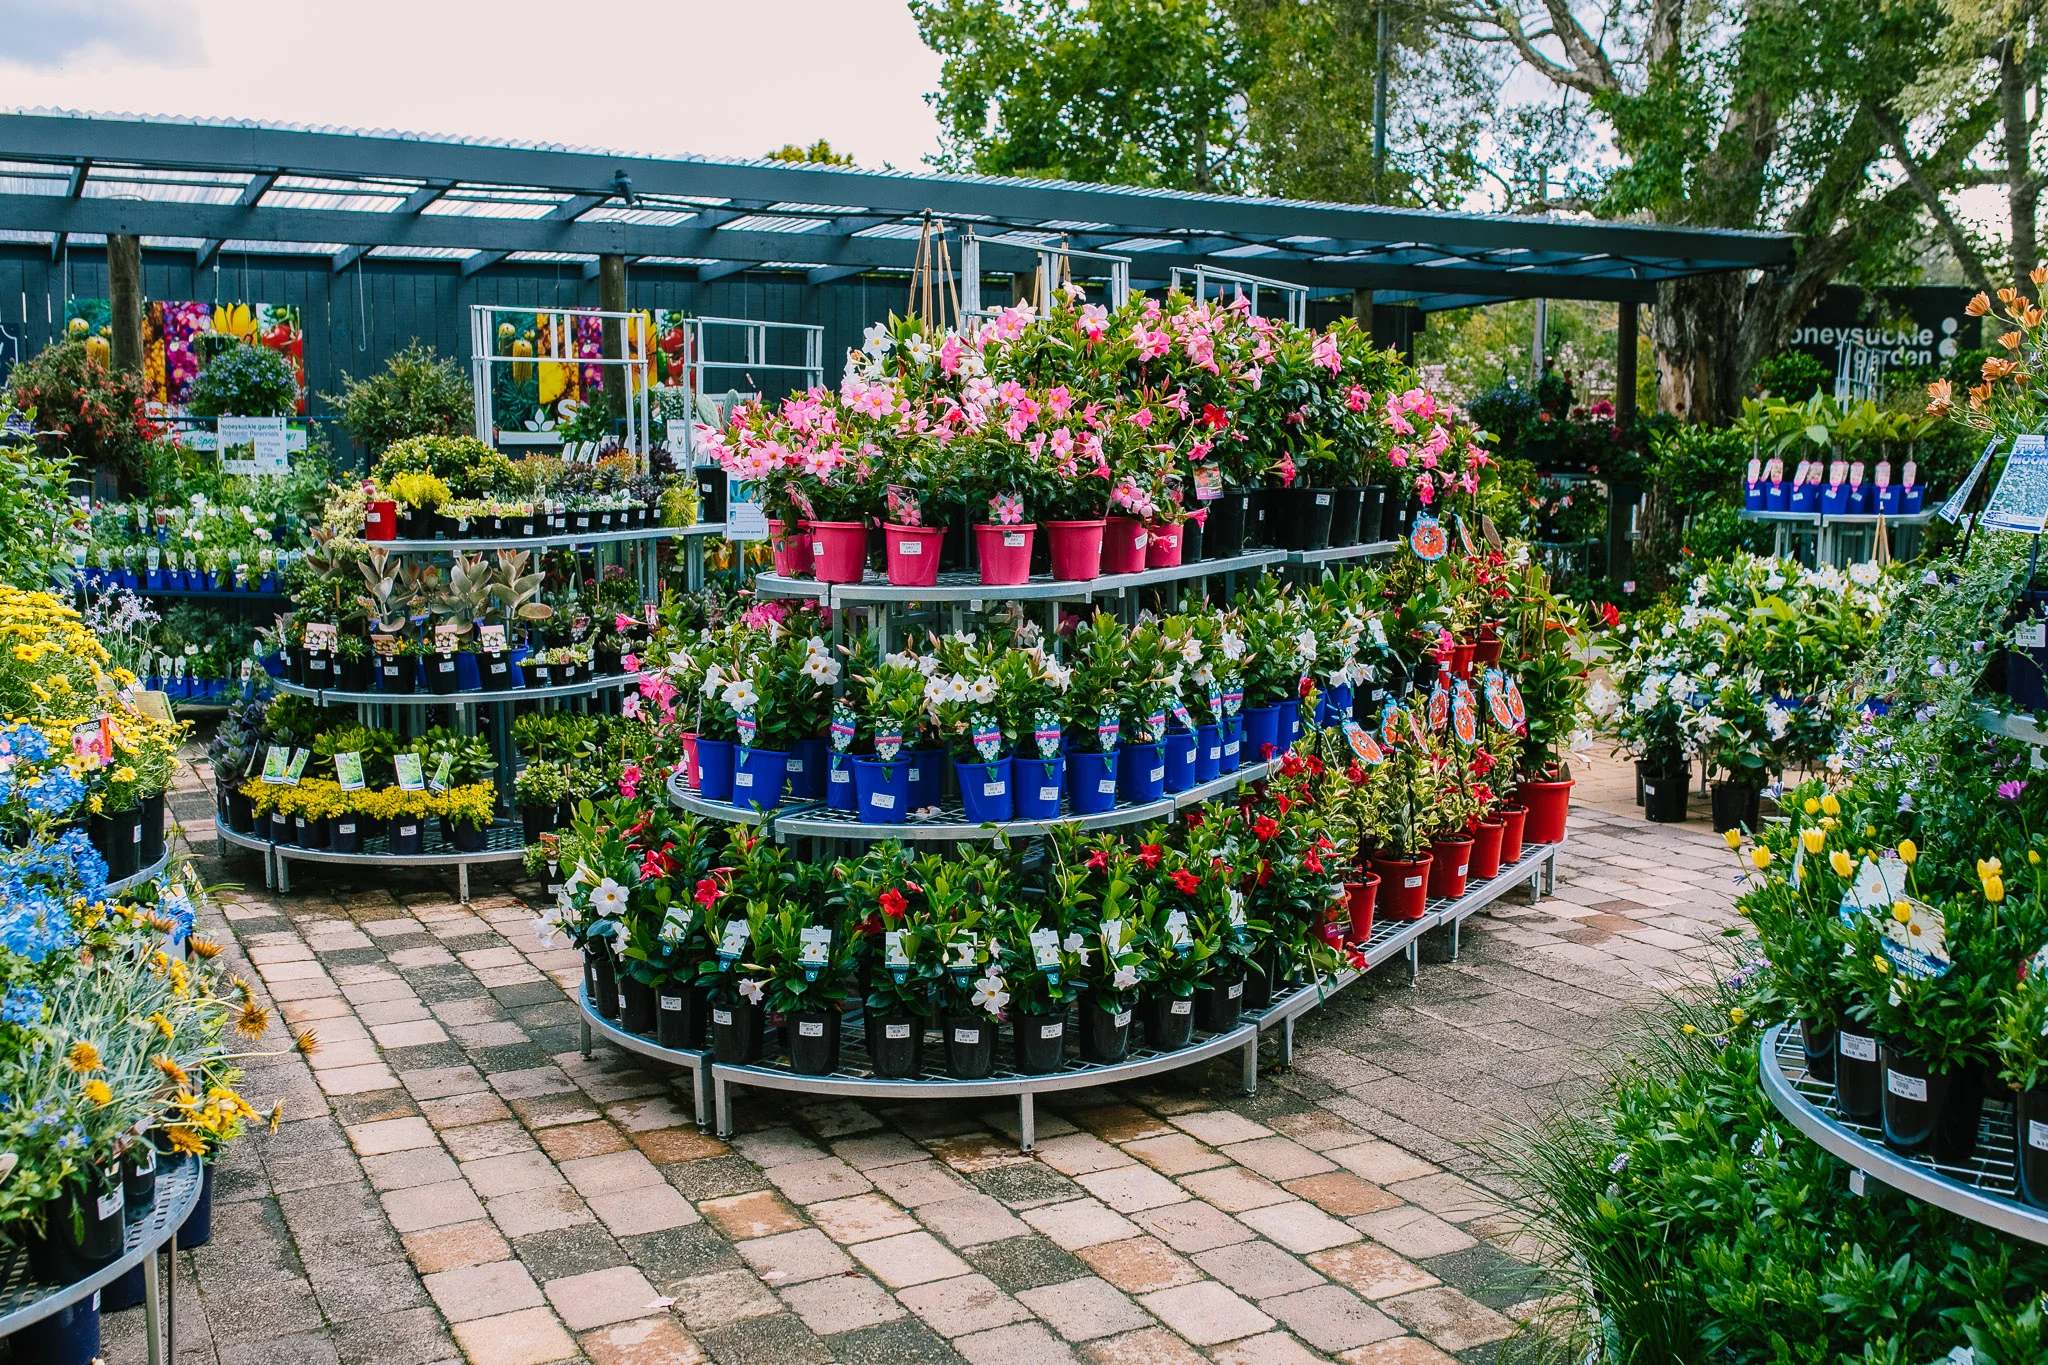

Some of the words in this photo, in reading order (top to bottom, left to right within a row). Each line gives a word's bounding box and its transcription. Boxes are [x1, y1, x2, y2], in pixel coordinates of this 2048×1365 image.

[1791, 323, 1934, 350] oneysuckle
[1854, 346, 1932, 368] garden
[2015, 443, 2046, 455] TWO
[76, 722, 99, 733] always
